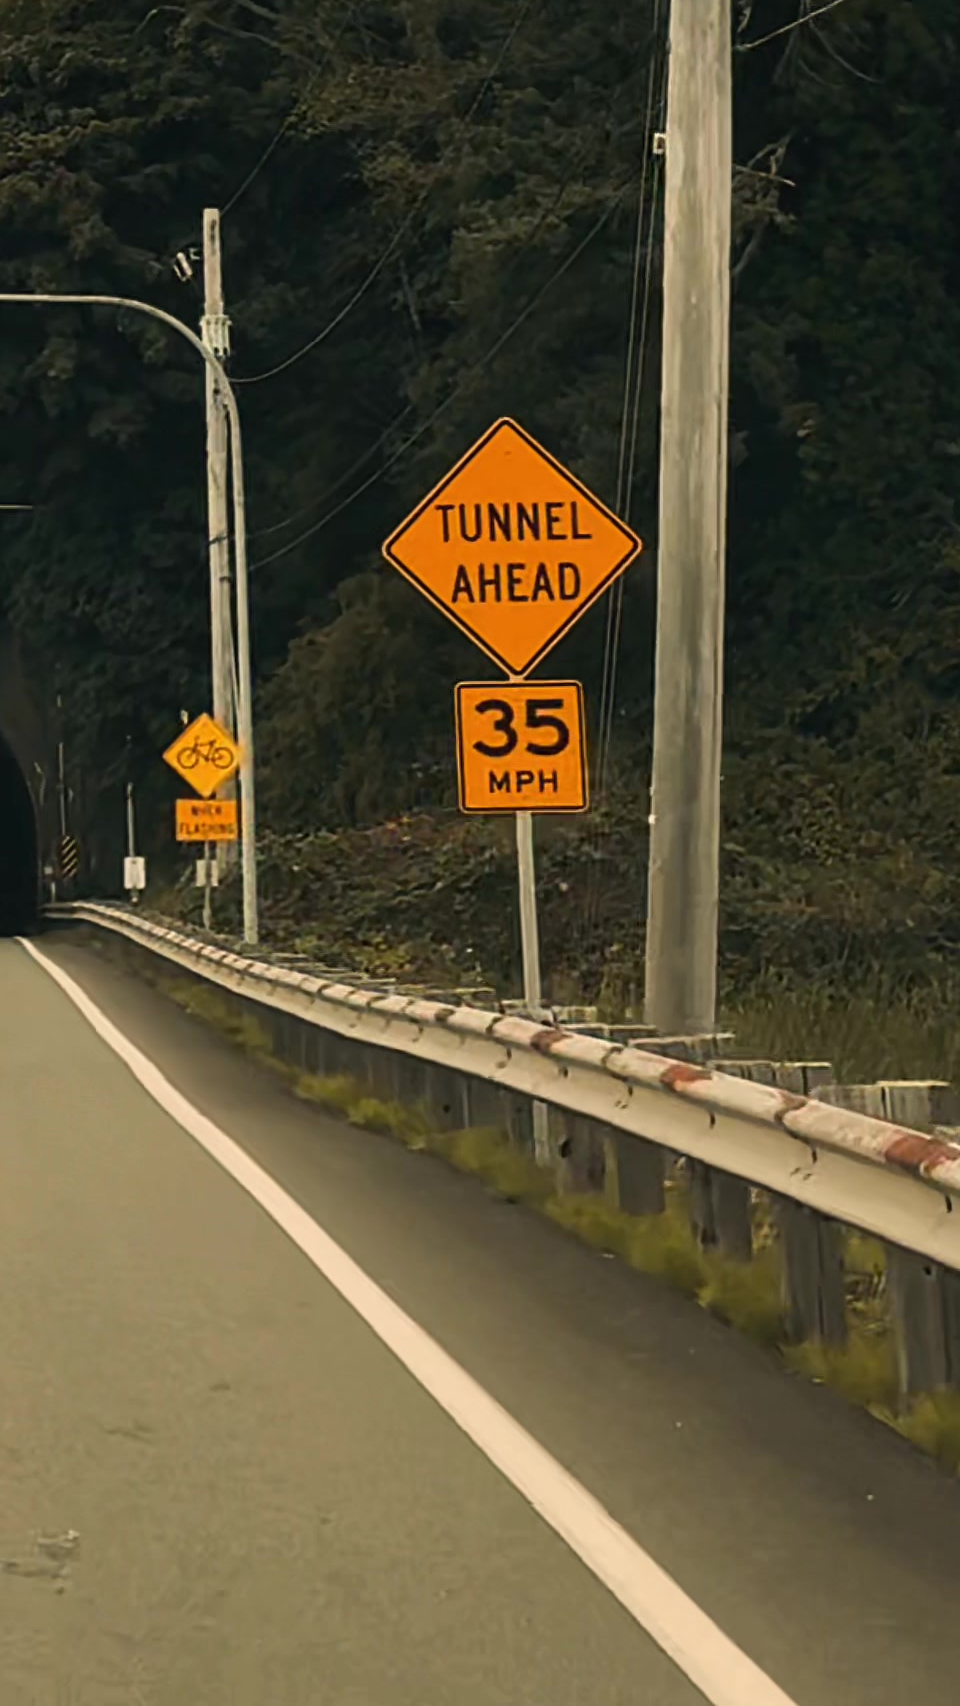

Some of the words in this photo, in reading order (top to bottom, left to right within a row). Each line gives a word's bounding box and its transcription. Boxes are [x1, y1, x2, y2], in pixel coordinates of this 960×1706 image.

[435, 501, 592, 542] TUNNEL
[451, 562, 581, 603] AHEAD
[473, 698, 570, 758] 35
[489, 770, 558, 793] MPH
